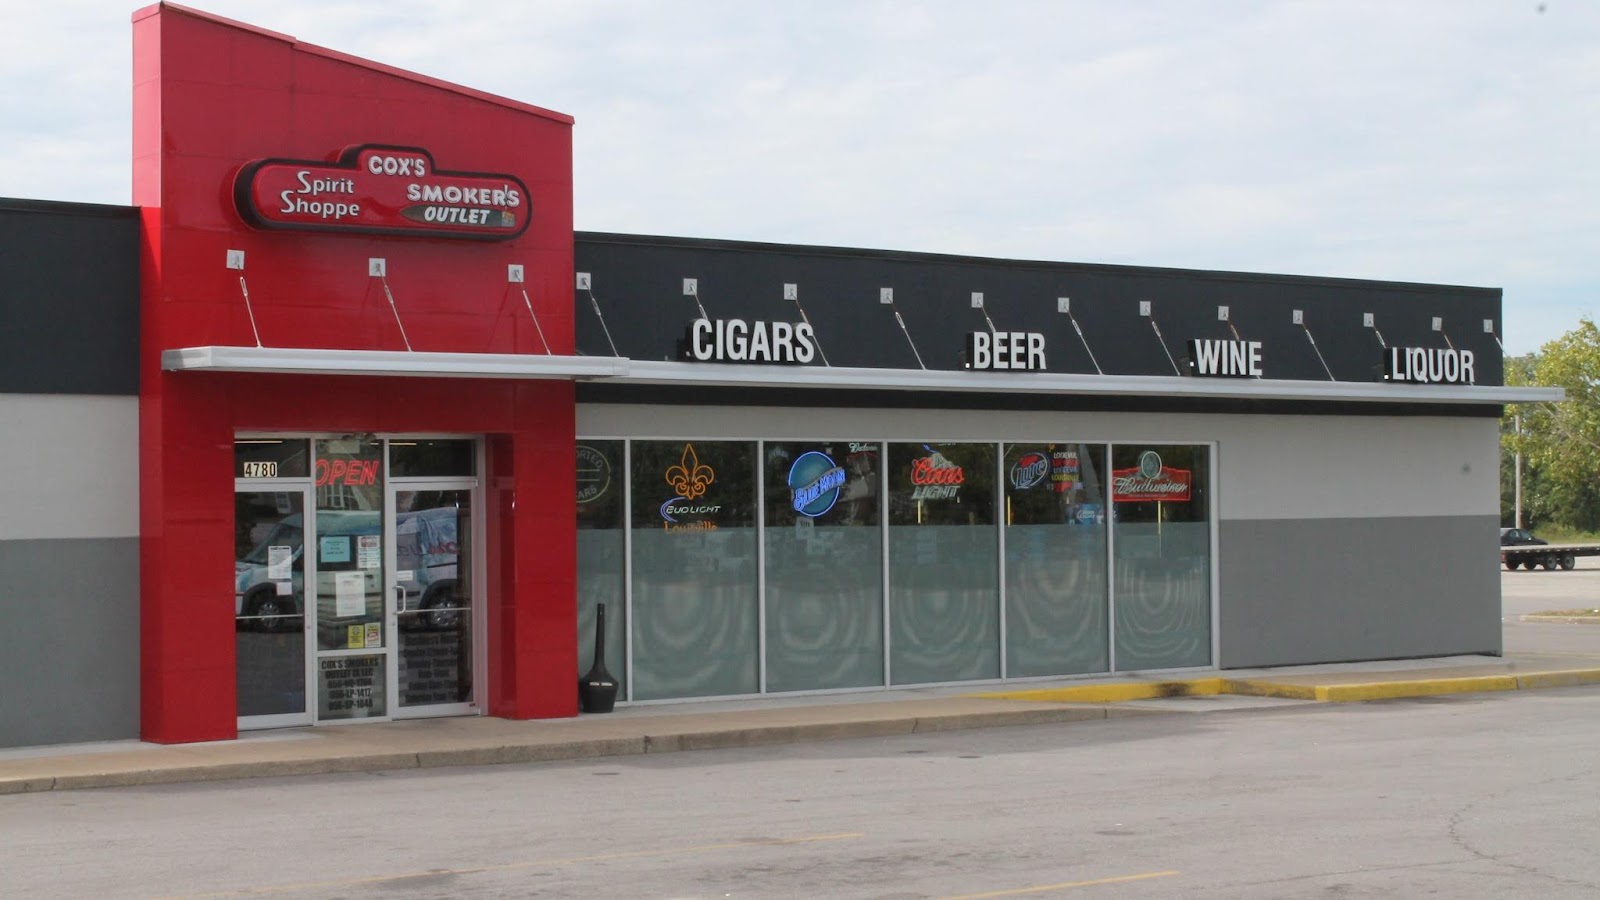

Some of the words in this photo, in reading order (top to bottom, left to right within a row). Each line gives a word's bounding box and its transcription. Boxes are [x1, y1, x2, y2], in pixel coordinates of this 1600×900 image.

[368, 155, 426, 178] COX'S
[297, 171, 354, 197] Spirit
[406, 183, 520, 208] SMOKER'S
[280, 190, 360, 219] Shoppe
[424, 205, 491, 225] OUTLET
[692, 318, 815, 363] CIGARS
[972, 331, 1047, 370] BEER
[1195, 338, 1263, 376] WINE
[1392, 346, 1476, 384] LIQUOR
[244, 462, 277, 478] 4780
[315, 458, 380, 487] OPEN
[911, 457, 964, 486] Coors
[911, 485, 961, 500] LIGHT
[1114, 477, 1189, 495] Budweiser
[665, 505, 689, 514] BUD
[690, 505, 722, 514] LIGHT
